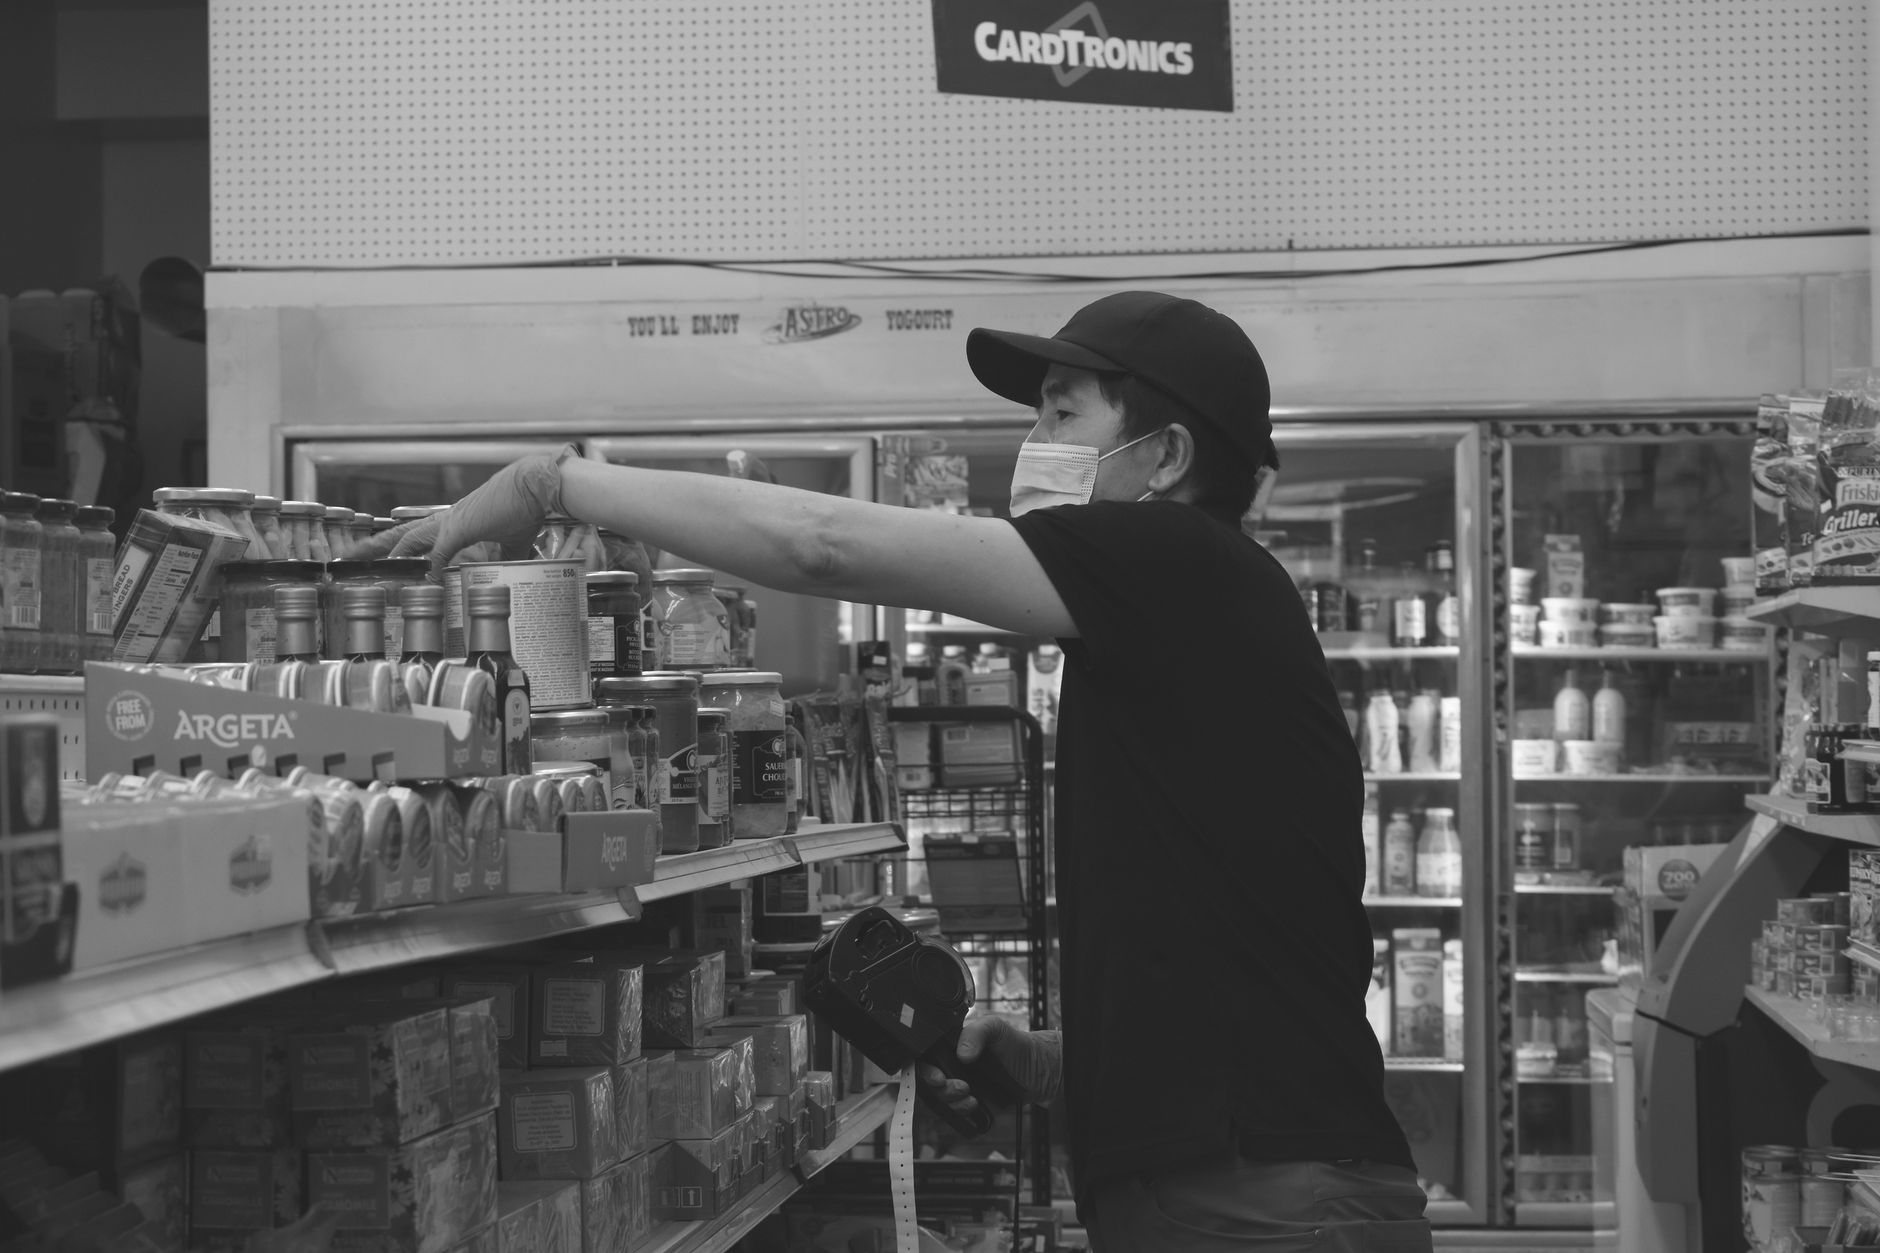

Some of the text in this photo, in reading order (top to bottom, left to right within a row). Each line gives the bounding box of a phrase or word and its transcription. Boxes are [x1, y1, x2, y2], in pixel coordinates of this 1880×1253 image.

[974, 21, 1194, 75] CARDTRONICS
[692, 314, 739, 334] ENJOY
[785, 307, 848, 336] ASTRO
[885, 309, 953, 330] YOGOURT
[1841, 484, 1880, 502] Friski
[113, 564, 130, 595] BREAD
[115, 698, 142, 715] FREE
[114, 713, 146, 731] FROM
[172, 709, 295, 748] ARGETA
[601, 832, 628, 872] ARGETA
[1663, 871, 1695, 882] 700
